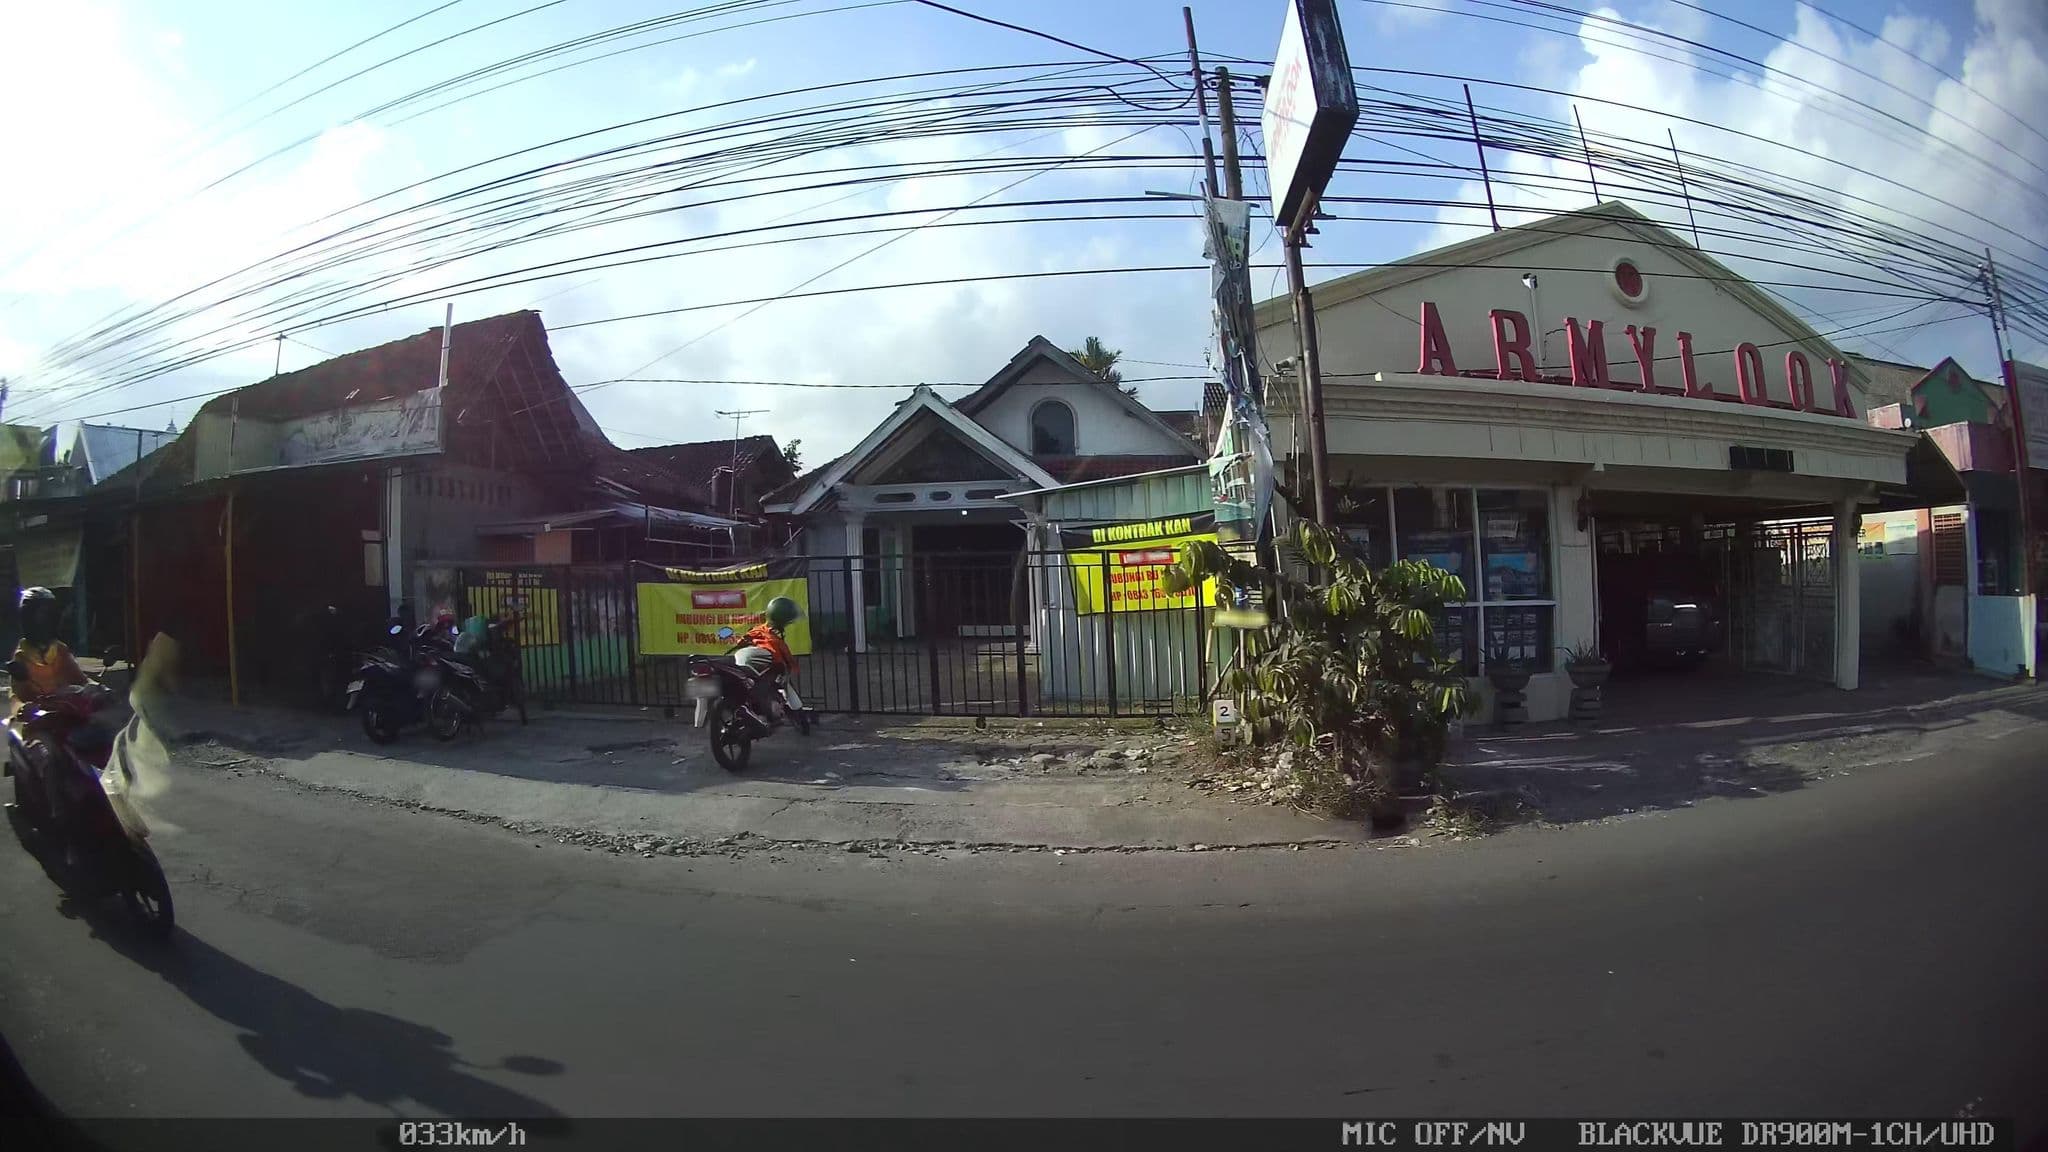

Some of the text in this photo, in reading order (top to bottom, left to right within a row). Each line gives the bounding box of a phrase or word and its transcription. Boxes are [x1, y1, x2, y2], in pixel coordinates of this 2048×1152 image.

[1092, 517, 1192, 543] DI KONTRAK KAN
[1146, 569, 1159, 581] BU
[1219, 705, 1230, 717] 2
